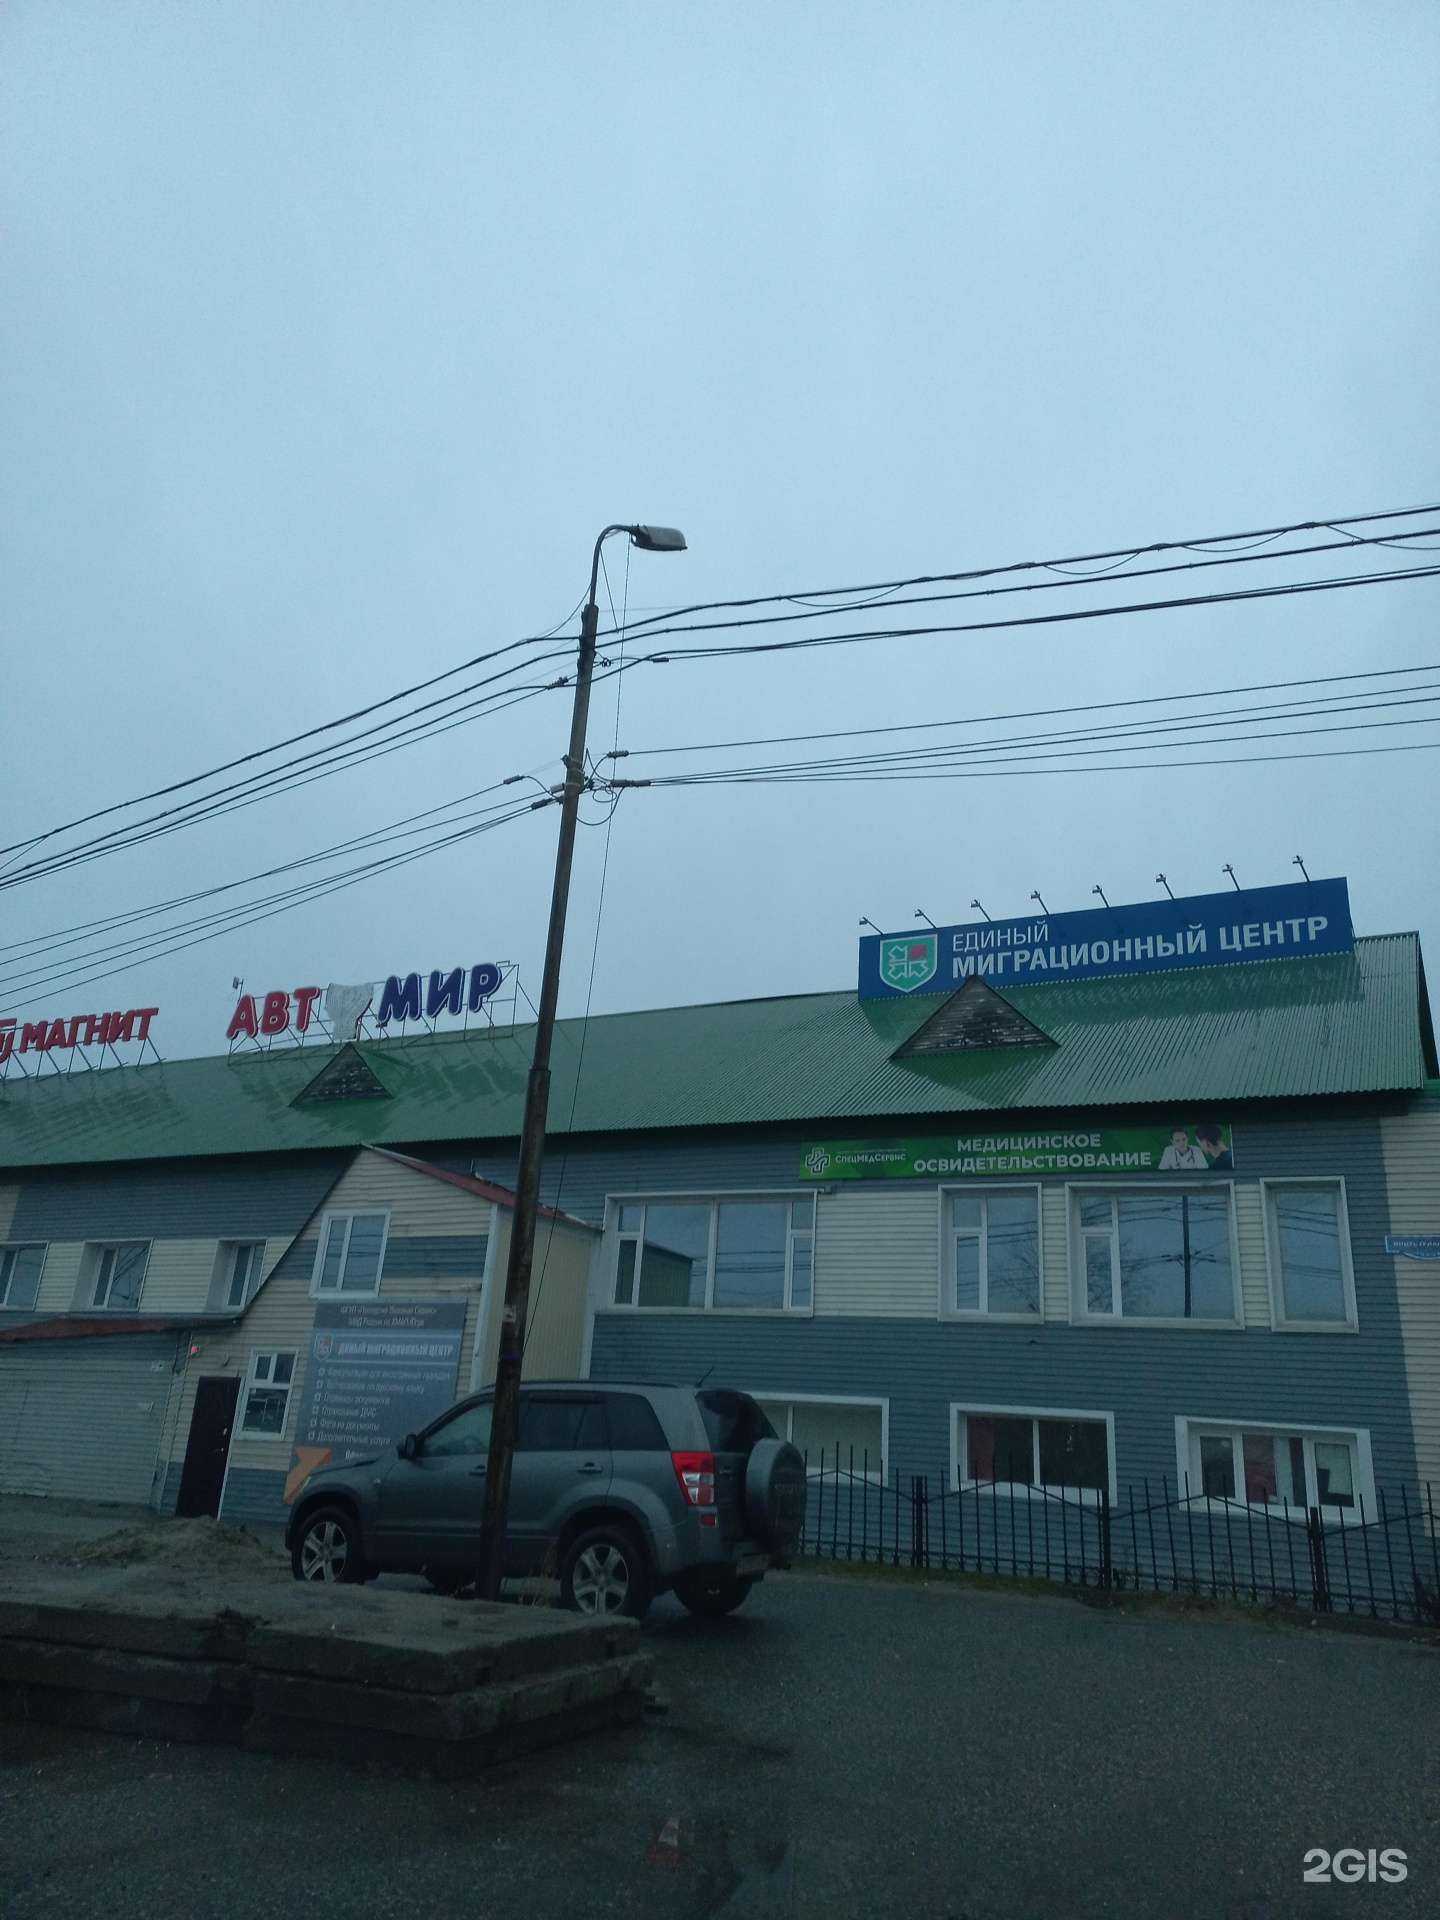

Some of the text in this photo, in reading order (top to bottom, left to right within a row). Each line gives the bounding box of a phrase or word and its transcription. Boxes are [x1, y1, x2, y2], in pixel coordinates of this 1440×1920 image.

[952, 920, 1049, 953] ЕДИНЫЙ
[952, 915, 1329, 979] МИГРАЦИОННЫЙ ЦЕНТР
[18, 1007, 160, 1054] МАГНИТ
[957, 1133, 1101, 1153] МЕДИЦИНСКОЕ
[913, 1151, 1152, 1173] ОСВИДЕТЕЛЬСТВОВАНИЕ
